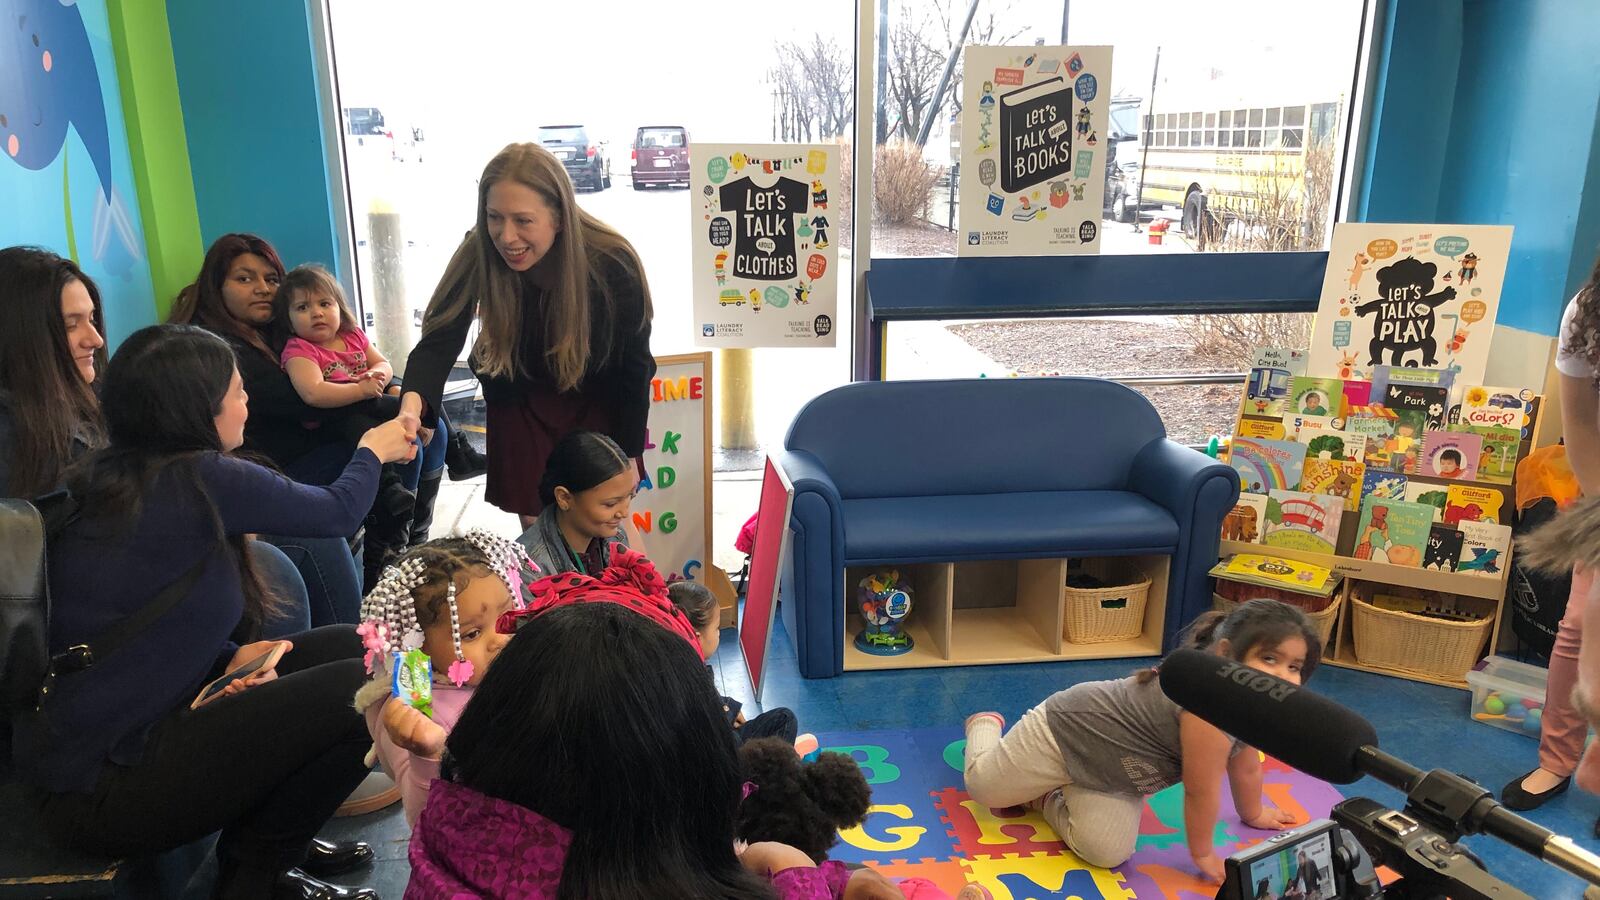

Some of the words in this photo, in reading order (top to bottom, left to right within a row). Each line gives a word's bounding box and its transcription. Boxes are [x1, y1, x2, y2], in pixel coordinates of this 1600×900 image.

[1016, 128, 1046, 152] TALK
[1050, 123, 1066, 135] ABOUT
[1014, 141, 1070, 178] BOOKS
[744, 213, 786, 237] TALK
[737, 254, 794, 276] CLOTHES
[1380, 302, 1415, 319] TALK
[1380, 319, 1428, 343] PLAY
[651, 376, 703, 402] IME
[1404, 396, 1426, 406] Park
[1462, 490, 1491, 499] Clifford
[1428, 537, 1443, 549] ity
[837, 804, 927, 852] G
